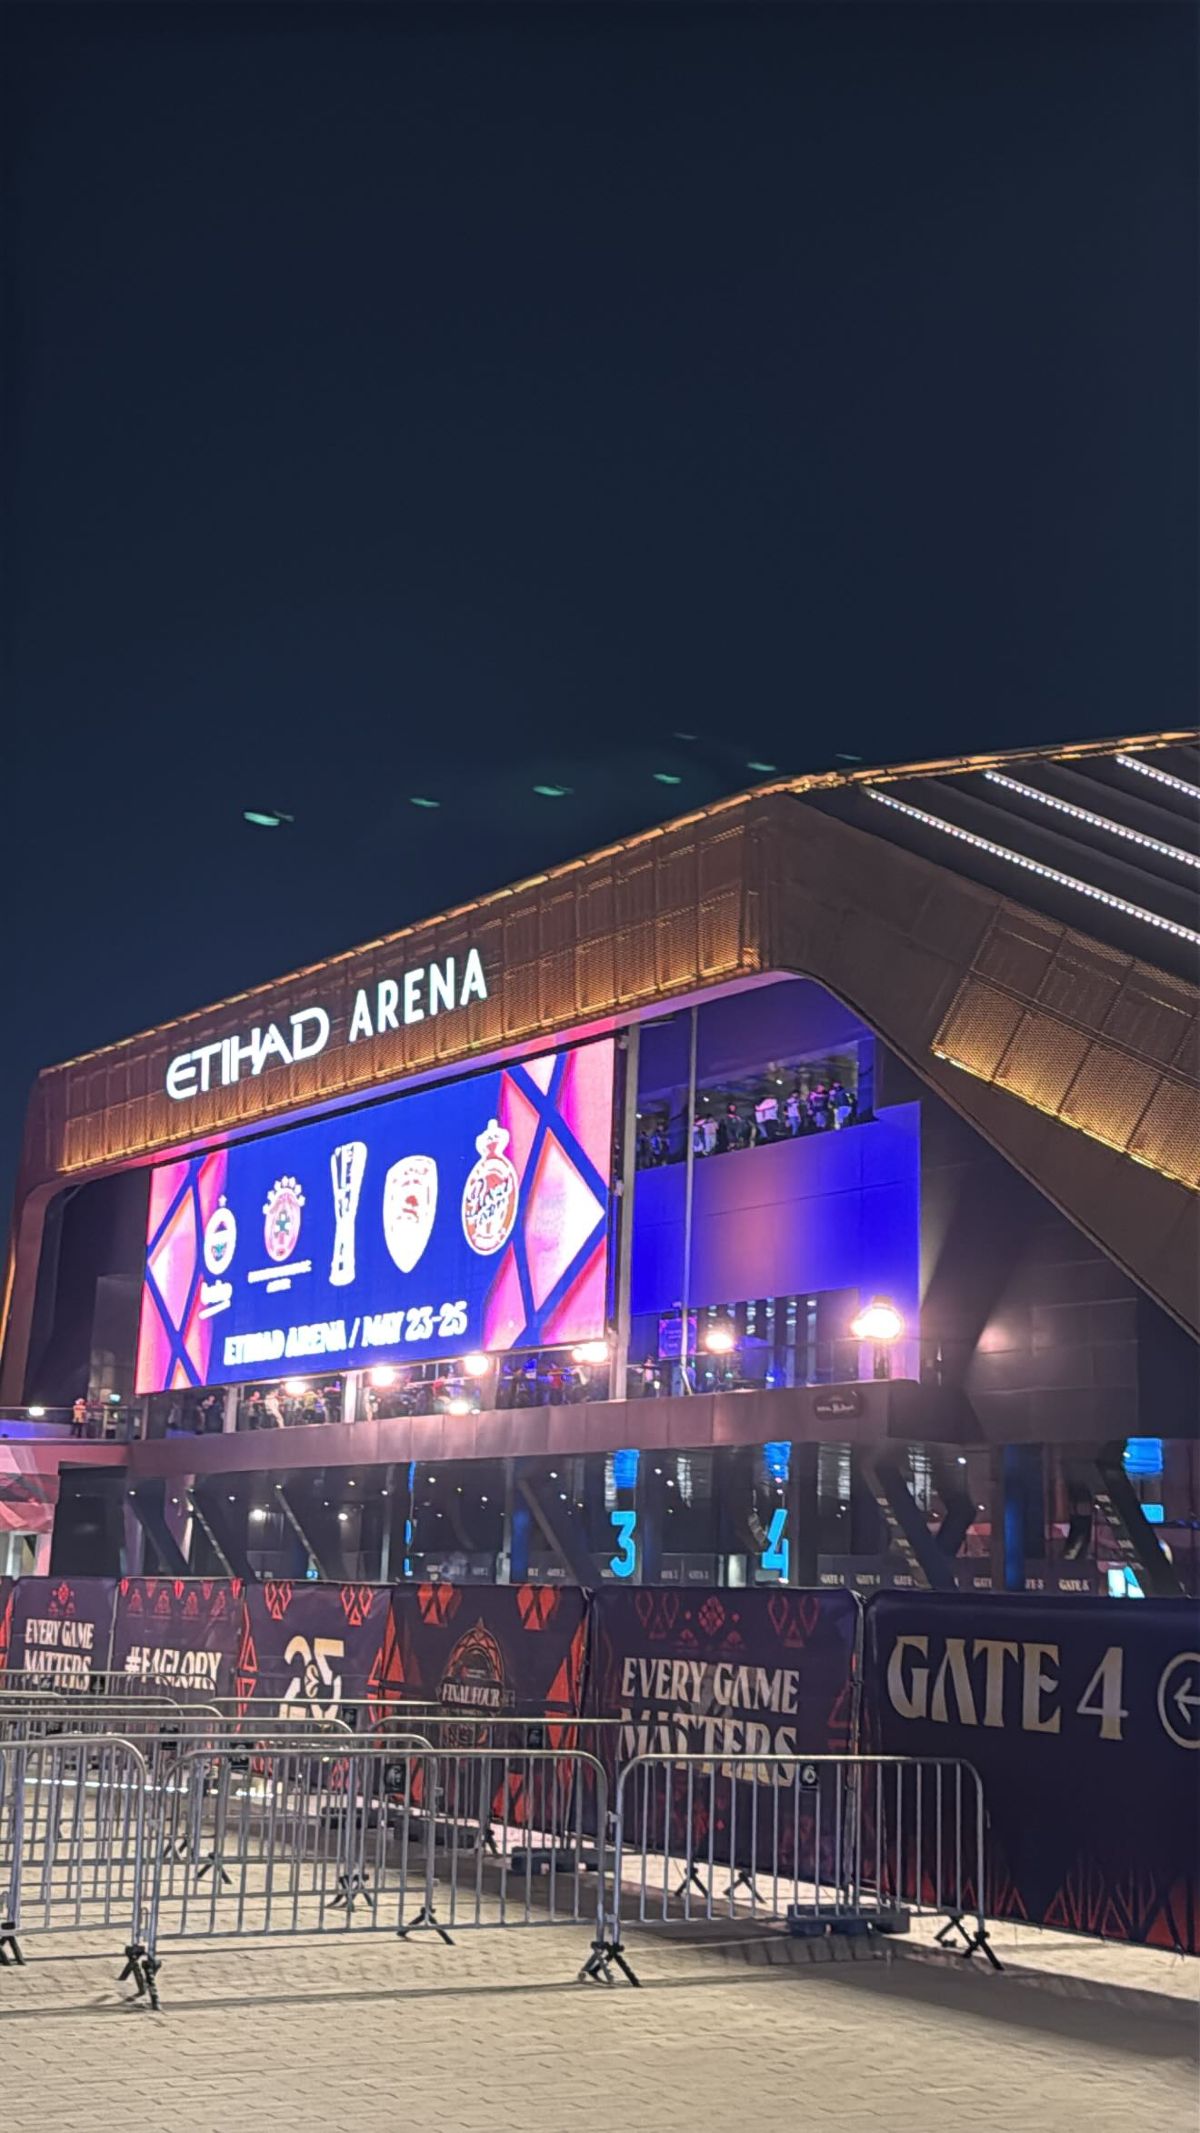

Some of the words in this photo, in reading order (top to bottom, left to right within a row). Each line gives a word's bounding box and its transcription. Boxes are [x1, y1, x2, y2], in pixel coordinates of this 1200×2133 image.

[166, 1006, 330, 1100] ETIHAD
[349, 948, 487, 1042] ARENA
[361, 1311, 405, 1347] MAY
[405, 1300, 468, 1342] 23-25
[610, 1510, 637, 1577] 3
[761, 1508, 789, 1584] 4
[25, 1618, 59, 1647] EVERY
[61, 1620, 95, 1650] GAME
[23, 1649, 92, 1691] MATTERS
[621, 1657, 708, 1703] EVERY
[713, 1662, 800, 1715] GAME
[887, 1635, 1061, 1734] GATE
[1076, 1646, 1130, 1741] 4
[615, 1707, 798, 1787] MATTERS
